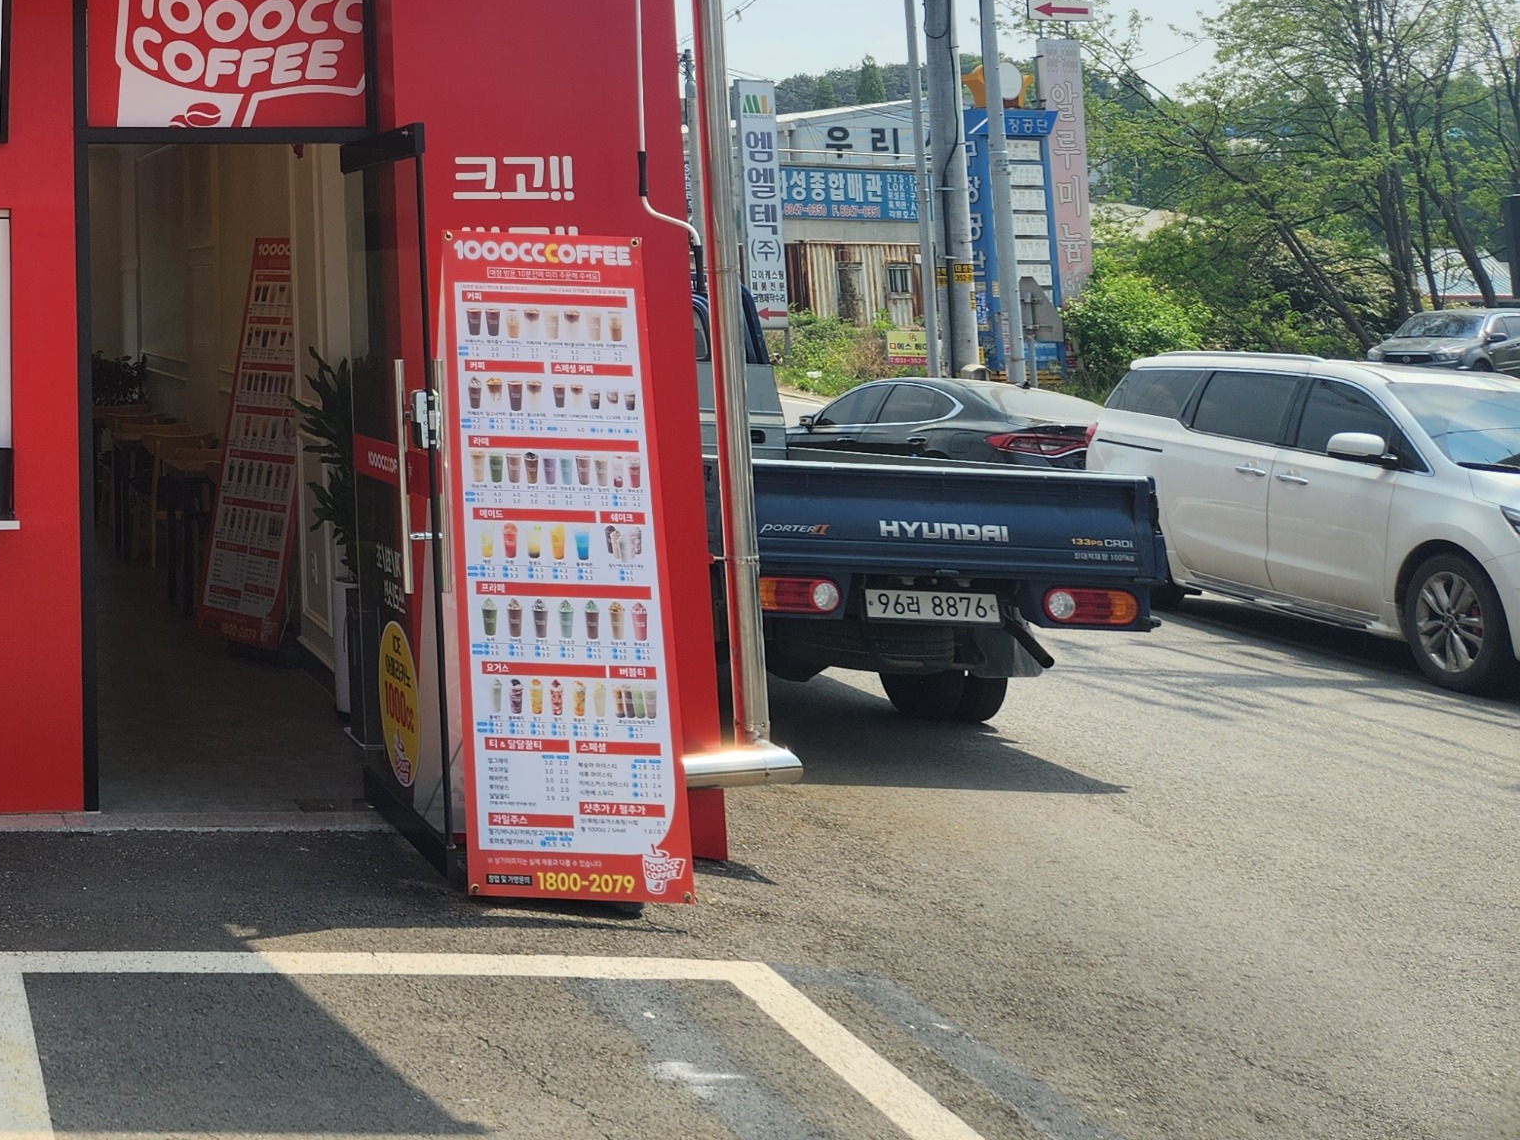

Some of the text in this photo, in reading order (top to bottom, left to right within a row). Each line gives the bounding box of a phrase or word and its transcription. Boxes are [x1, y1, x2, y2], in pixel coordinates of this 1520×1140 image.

[132, 26, 344, 88] COFFEE
[1008, 118, 1048, 134] 장공단
[453, 155, 575, 201] 크고!!
[1050, 80, 1088, 266] 알루미늄
[453, 240, 632, 266] 1000CCCOFFEE
[467, 292, 482, 300] 커피
[470, 362, 485, 370] 커피
[554, 364, 593, 374] 스페셜 커피
[473, 437, 489, 446] 라떼
[479, 509, 503, 518] 에이드
[610, 513, 634, 522] 쉐이크
[879, 520, 1010, 542] HYUNDAI
[481, 584, 506, 593] 프라페
[878, 593, 988, 619] 96러 8876
[392, 634, 402, 657] ICE
[486, 663, 509, 673] 요거스
[619, 667, 646, 678] 버블티
[384, 681, 415, 734] 1000cc
[489, 739, 498, 748] 티
[508, 740, 542, 750] 달달꿀티
[580, 743, 606, 753] 스페셜
[583, 803, 646, 815] 샷추가 펄추가
[493, 815, 528, 824] 과일주스
[537, 872, 635, 894] 1800-2079
